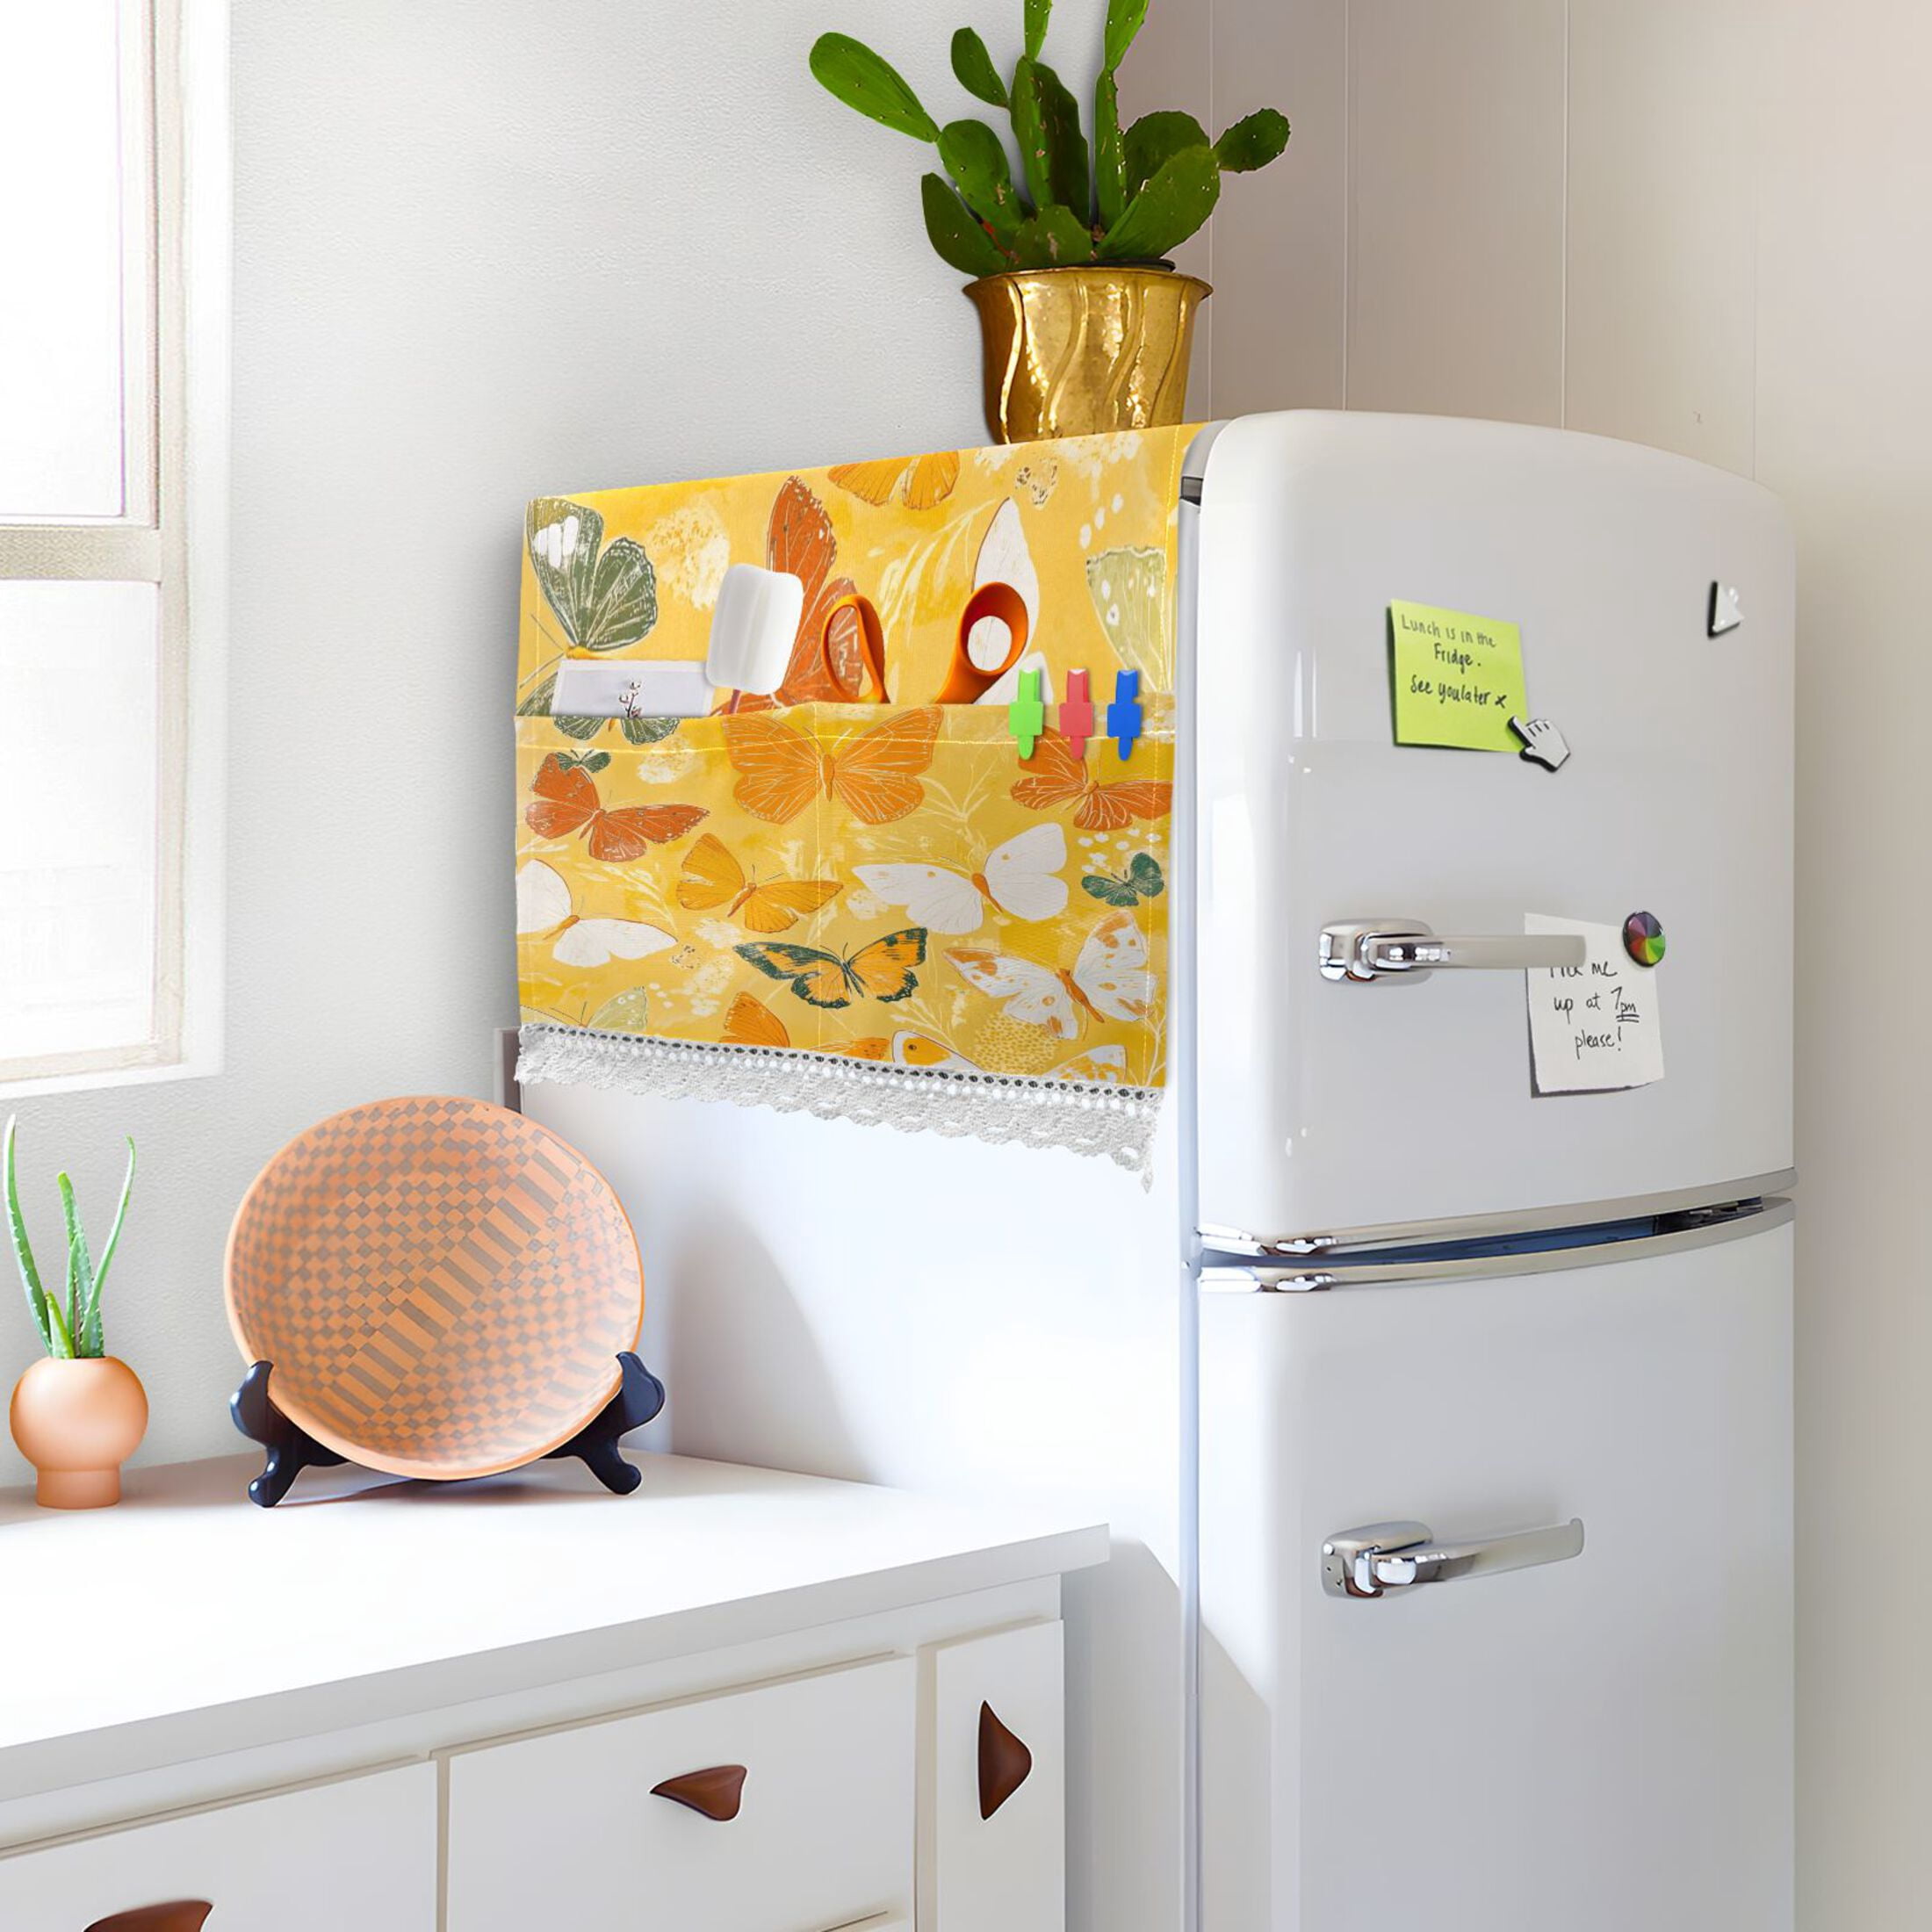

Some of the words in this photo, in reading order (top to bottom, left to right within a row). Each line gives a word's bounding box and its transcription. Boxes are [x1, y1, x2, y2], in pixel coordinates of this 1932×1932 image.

[1401, 613, 1441, 638] Lunch
[1445, 627, 1456, 641] is
[1460, 631, 1474, 643] in
[1477, 631, 1496, 648] the
[1410, 674, 1433, 695] See
[1554, 997, 1574, 1025] up
[1586, 992, 1601, 1011] at
[1575, 1026, 1622, 1060] please!
